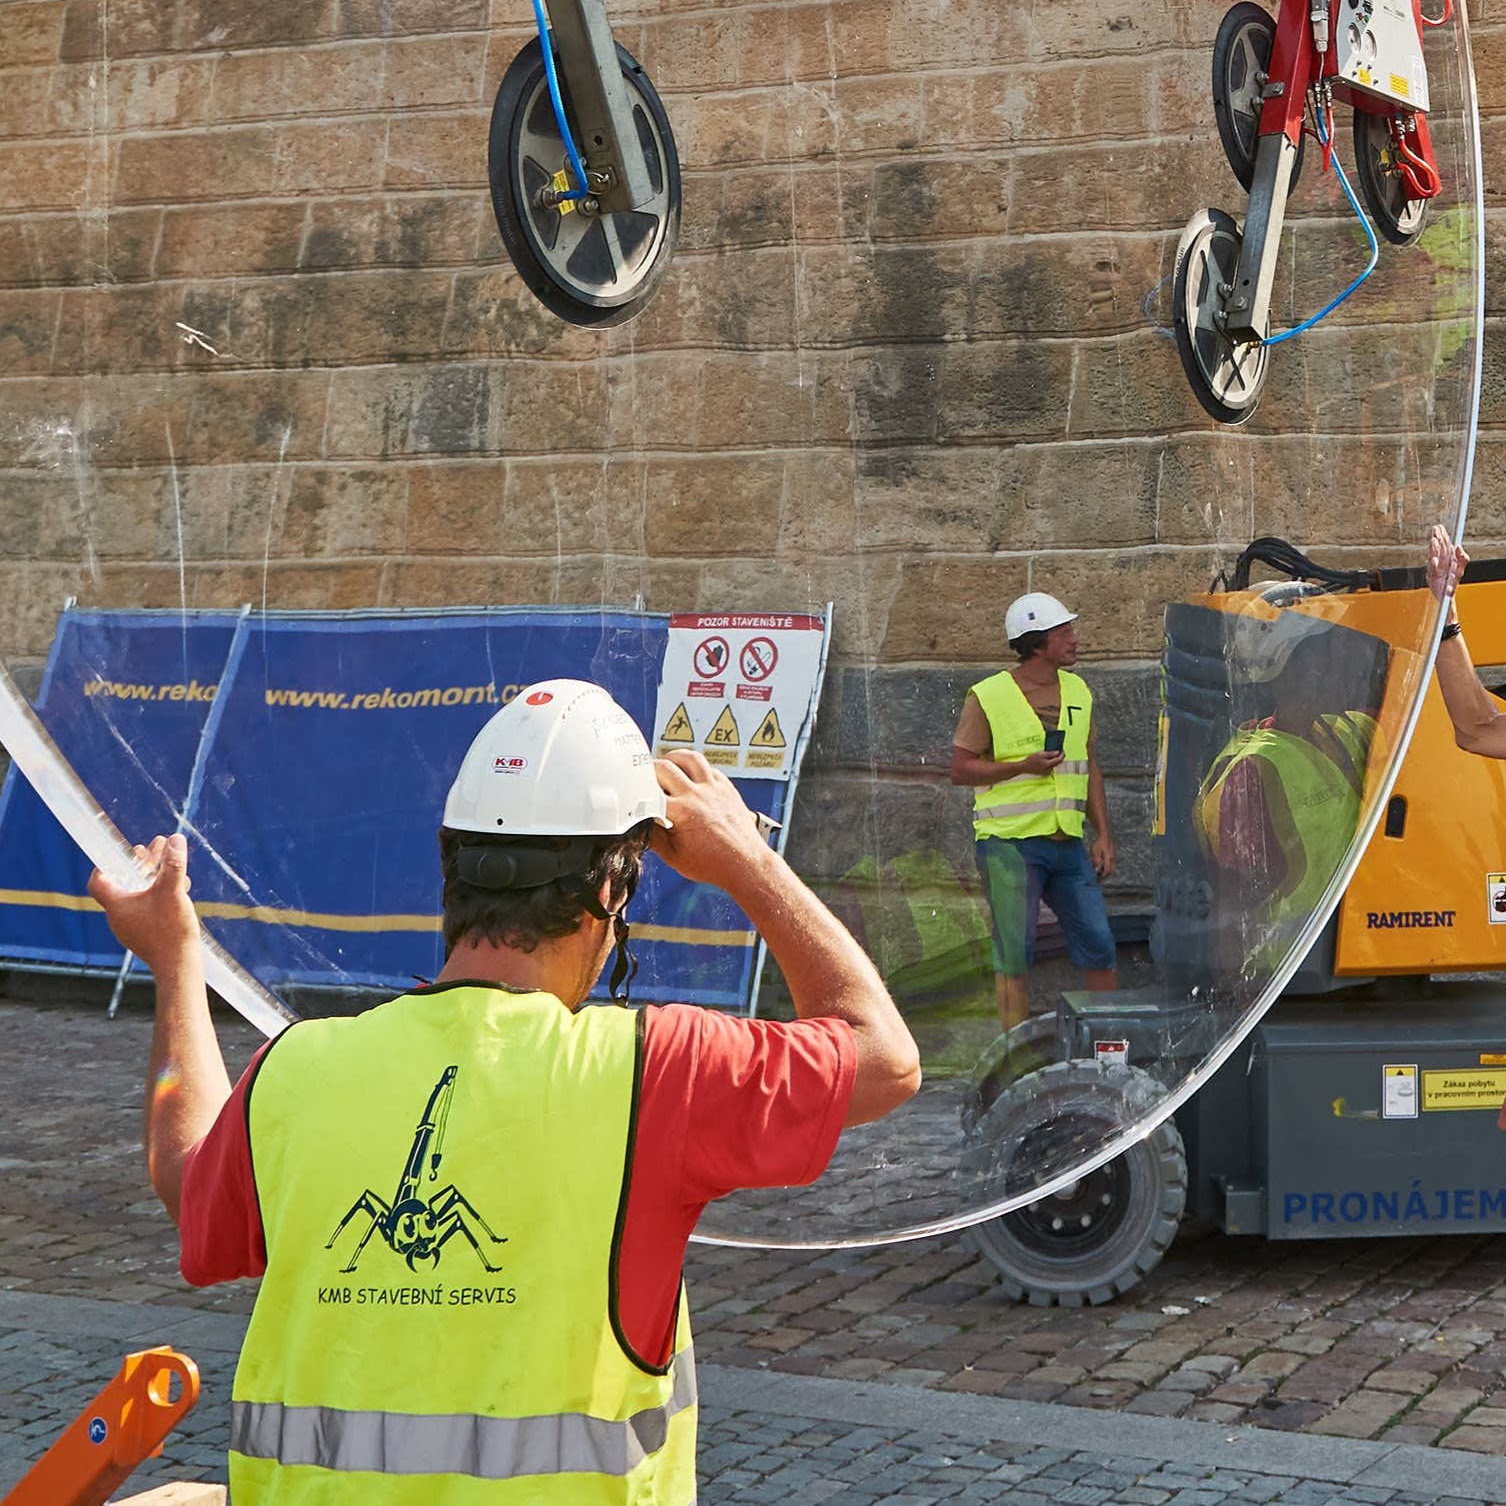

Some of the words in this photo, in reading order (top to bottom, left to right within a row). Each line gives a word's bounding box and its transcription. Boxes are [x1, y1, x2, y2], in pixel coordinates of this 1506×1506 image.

[697, 617, 730, 627] POZOR
[732, 616, 793, 627] STAVENIŠTĚ
[715, 728, 734, 742] EX
[1367, 911, 1456, 929] RAMIRENT
[1443, 1079, 1466, 1088] Zákaz
[1468, 1080, 1496, 1089] pobytu
[1434, 1090, 1476, 1099] pracovním
[317, 1287, 352, 1304] KMB
[356, 1283, 443, 1305] STAVEBNÍ
[448, 1287, 517, 1305] SERVIS
